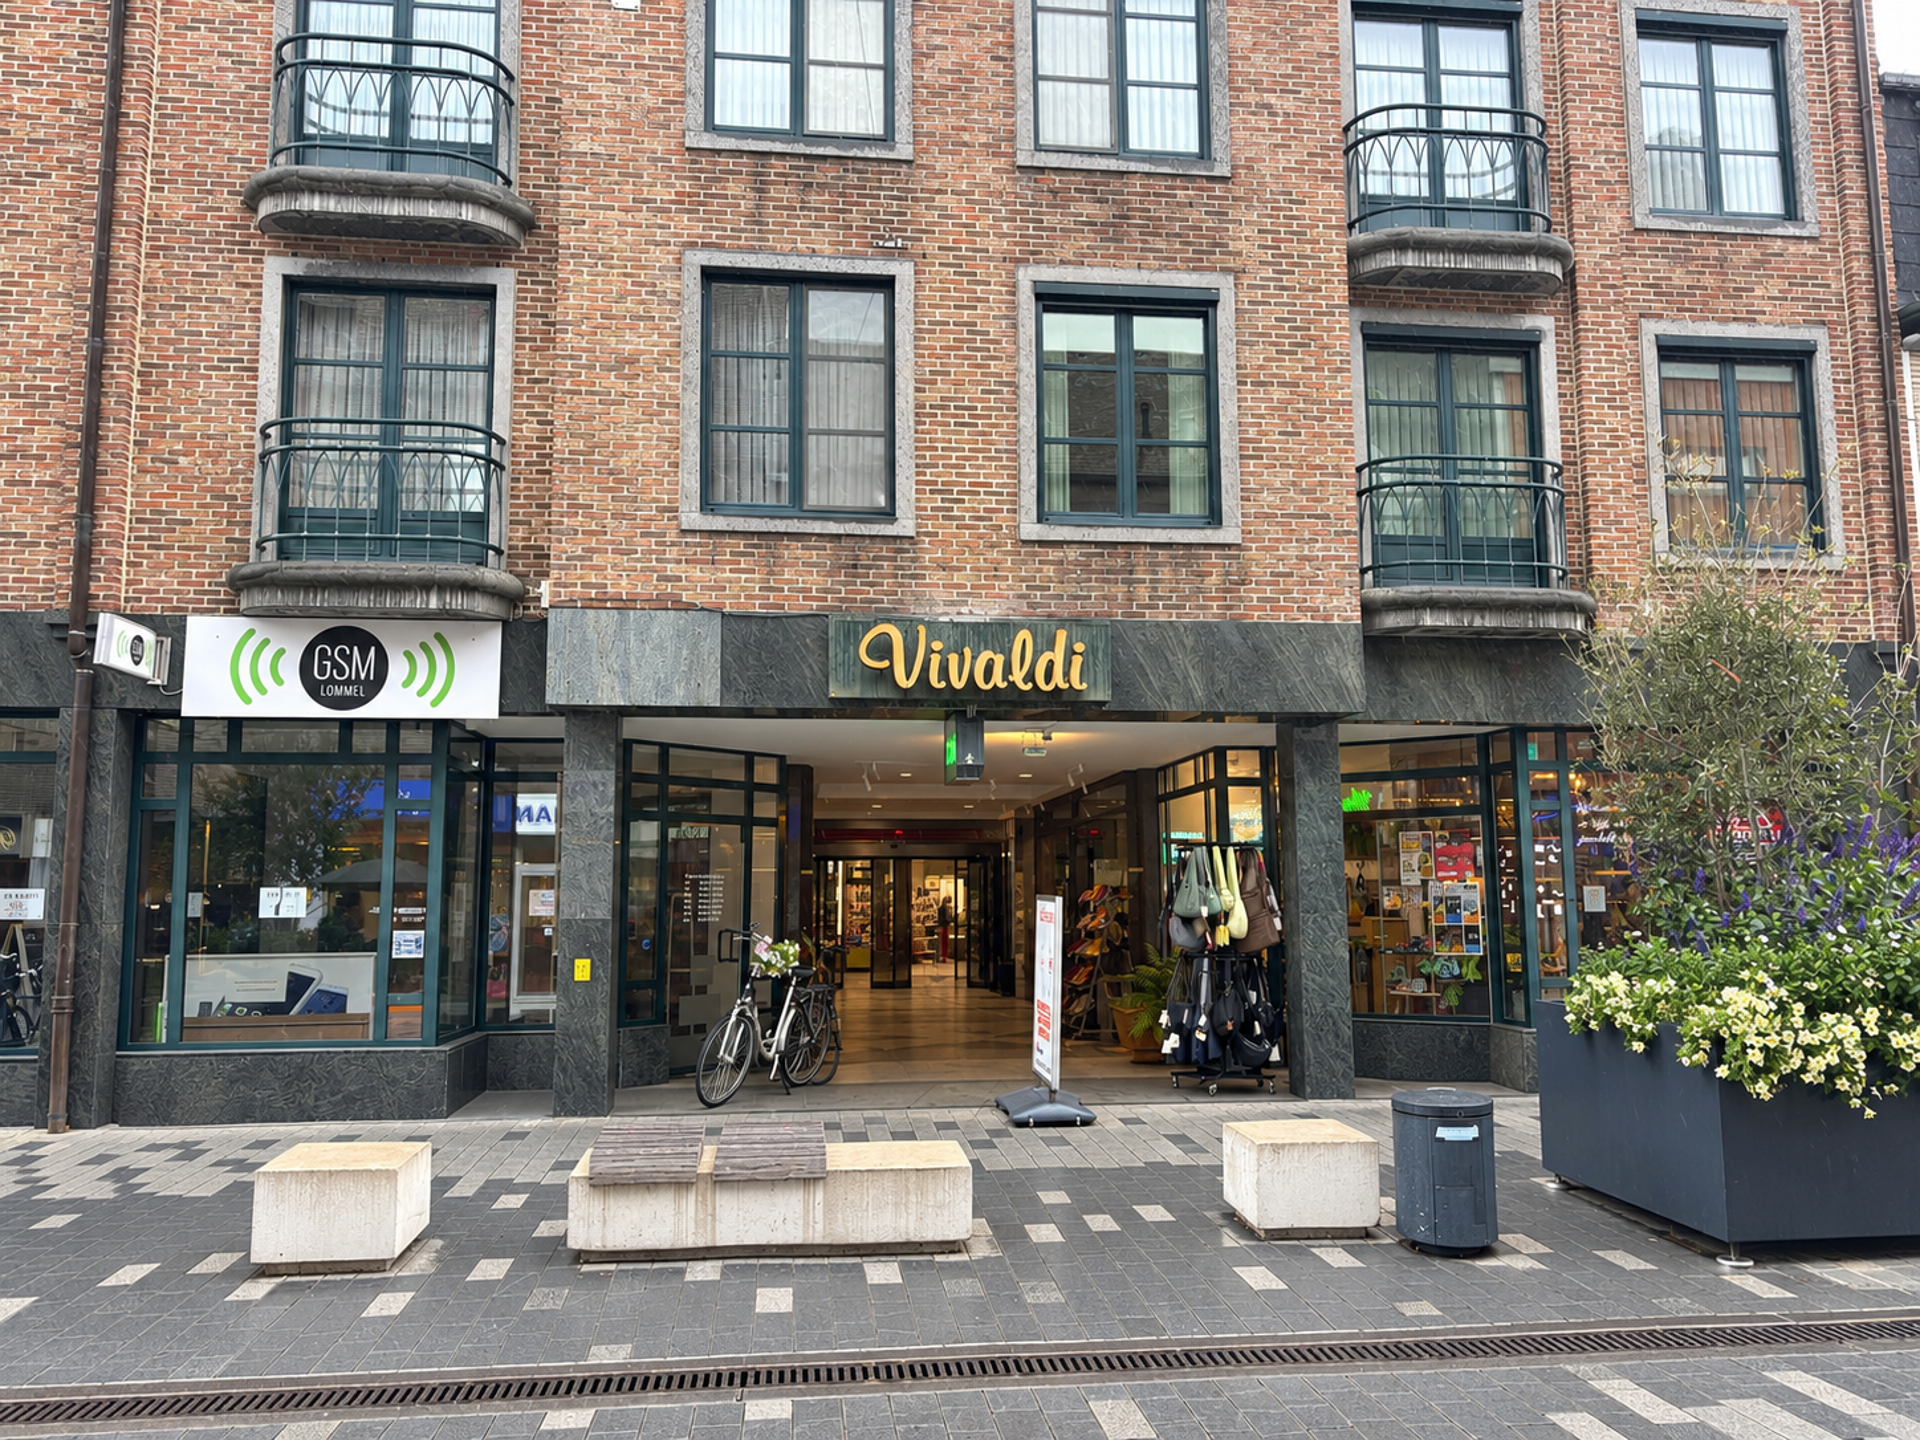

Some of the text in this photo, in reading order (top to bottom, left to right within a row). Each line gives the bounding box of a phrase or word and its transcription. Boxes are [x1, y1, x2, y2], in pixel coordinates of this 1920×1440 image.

[313, 643, 376, 681] GSM
[858, 623, 1088, 692] Vivaldi
[320, 684, 366, 697] LOMMEL
